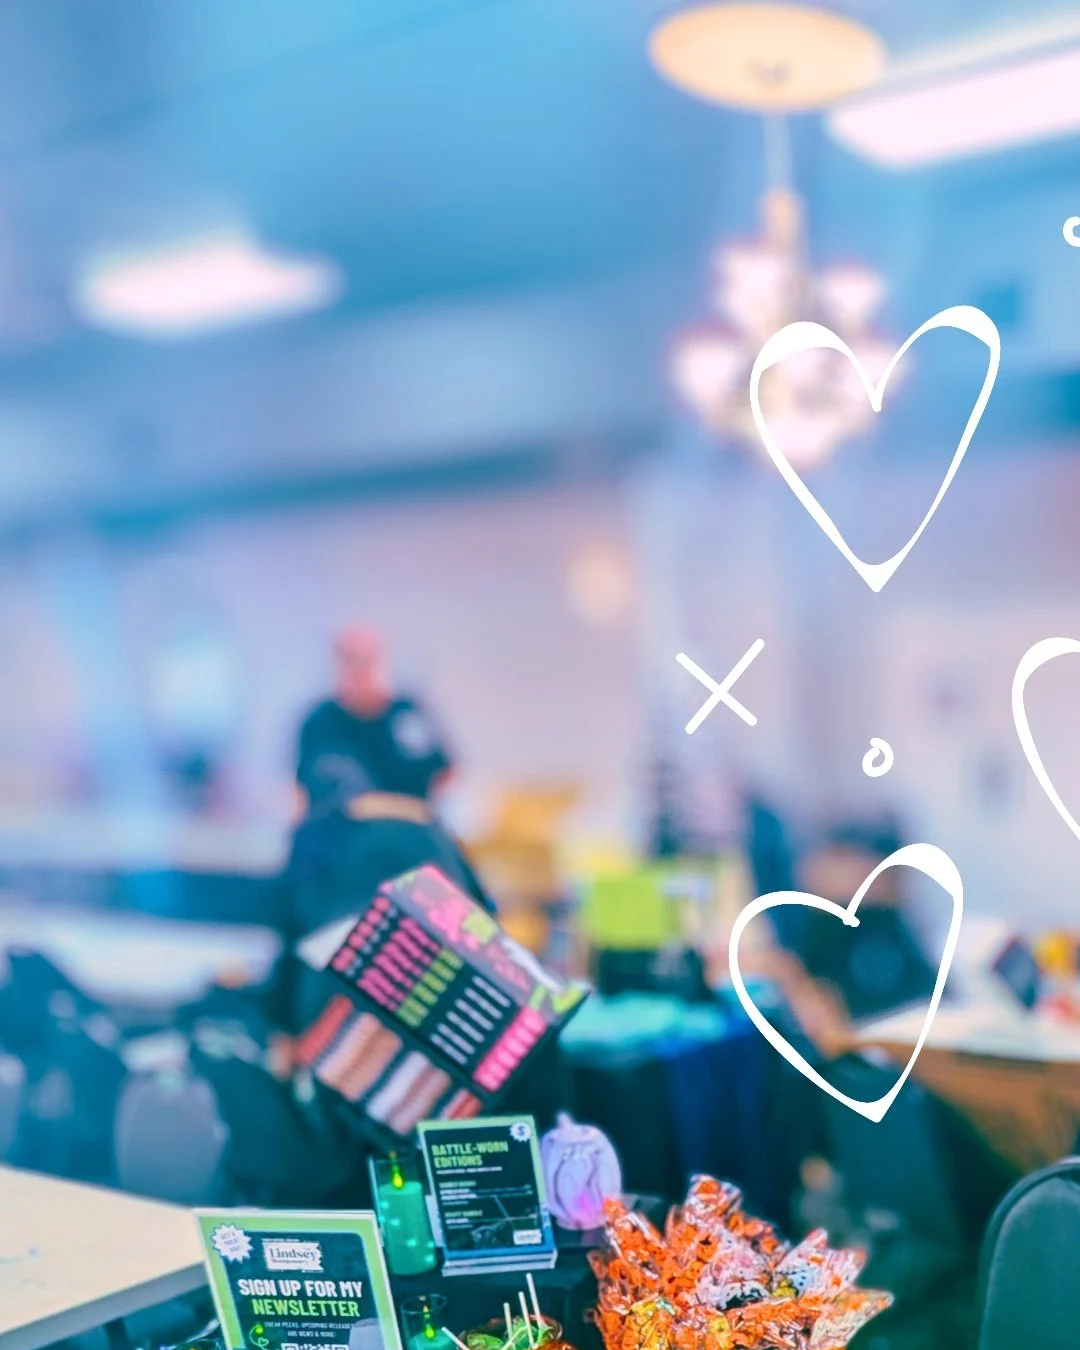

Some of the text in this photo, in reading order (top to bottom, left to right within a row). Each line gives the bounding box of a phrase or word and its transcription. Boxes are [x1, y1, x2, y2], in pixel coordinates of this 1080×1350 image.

[431, 1141, 509, 1156] BATTLE-WORN
[434, 1155, 483, 1168] EDITIONS
[269, 1248, 317, 1262] Lindsey
[237, 1279, 363, 1298] SIGN UP FOR MY
[251, 1298, 360, 1317] NEWSLETTER
